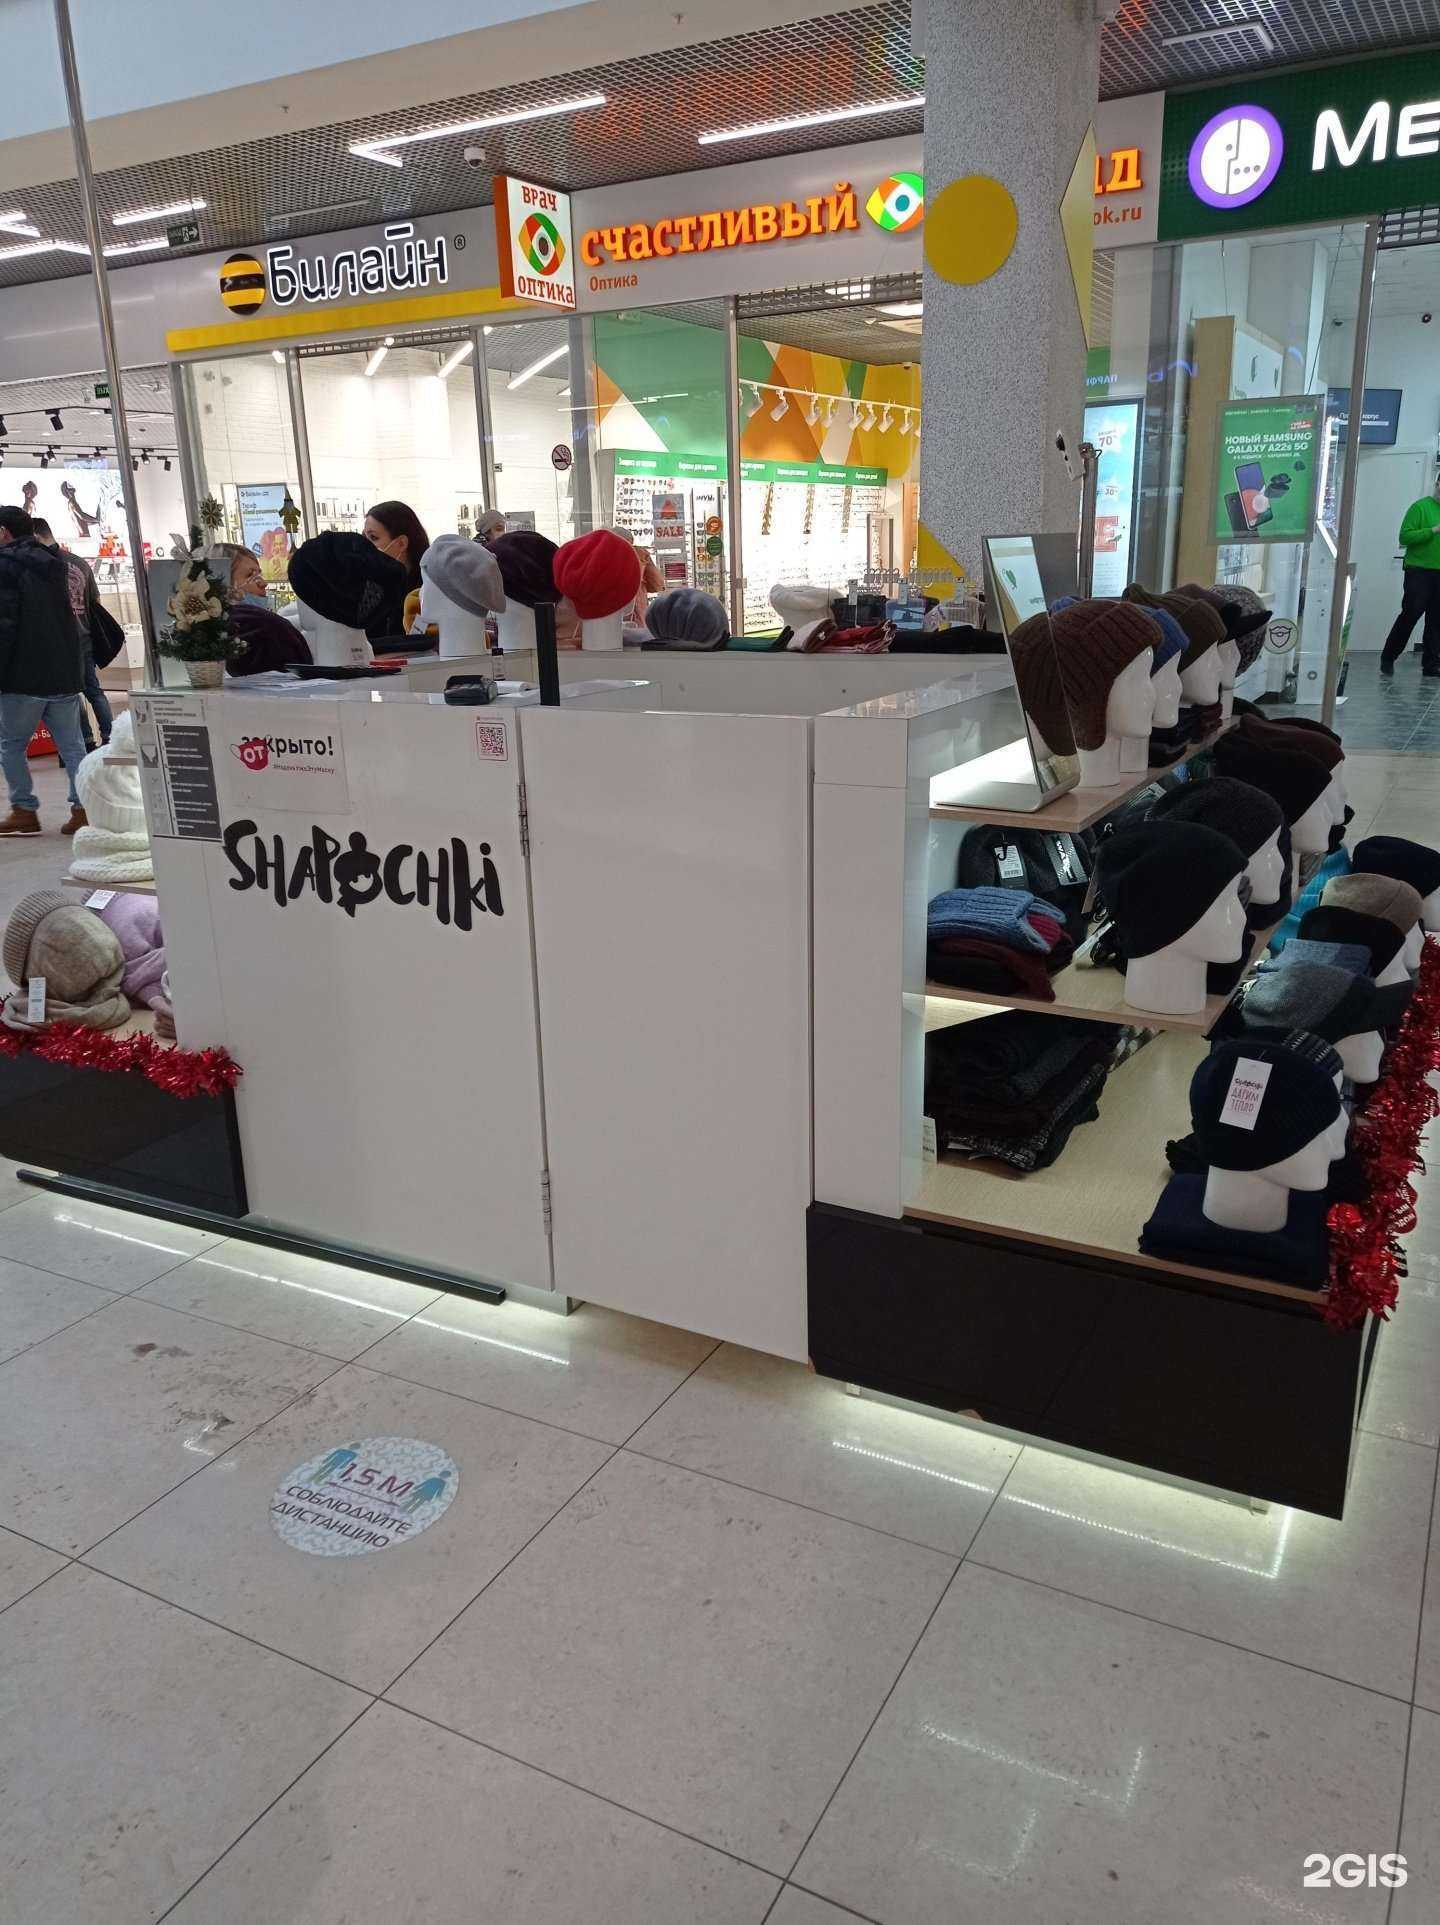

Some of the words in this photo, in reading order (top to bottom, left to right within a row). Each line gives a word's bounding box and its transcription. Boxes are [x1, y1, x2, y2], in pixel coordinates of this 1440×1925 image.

[580, 181, 860, 267] счастливый
[589, 273, 639, 292] Оптика
[1225, 434, 1261, 444] НОВЫЙ
[1263, 432, 1313, 442] SAMSUNG
[1227, 444, 1266, 454] GALAXY
[1294, 442, 1309, 450] 5G
[656, 526, 685, 537] SALE
[285, 1485, 413, 1535] СОБЛЮДАЙТЕ
[272, 1501, 391, 1548] ДИСТАНЦИЮ
